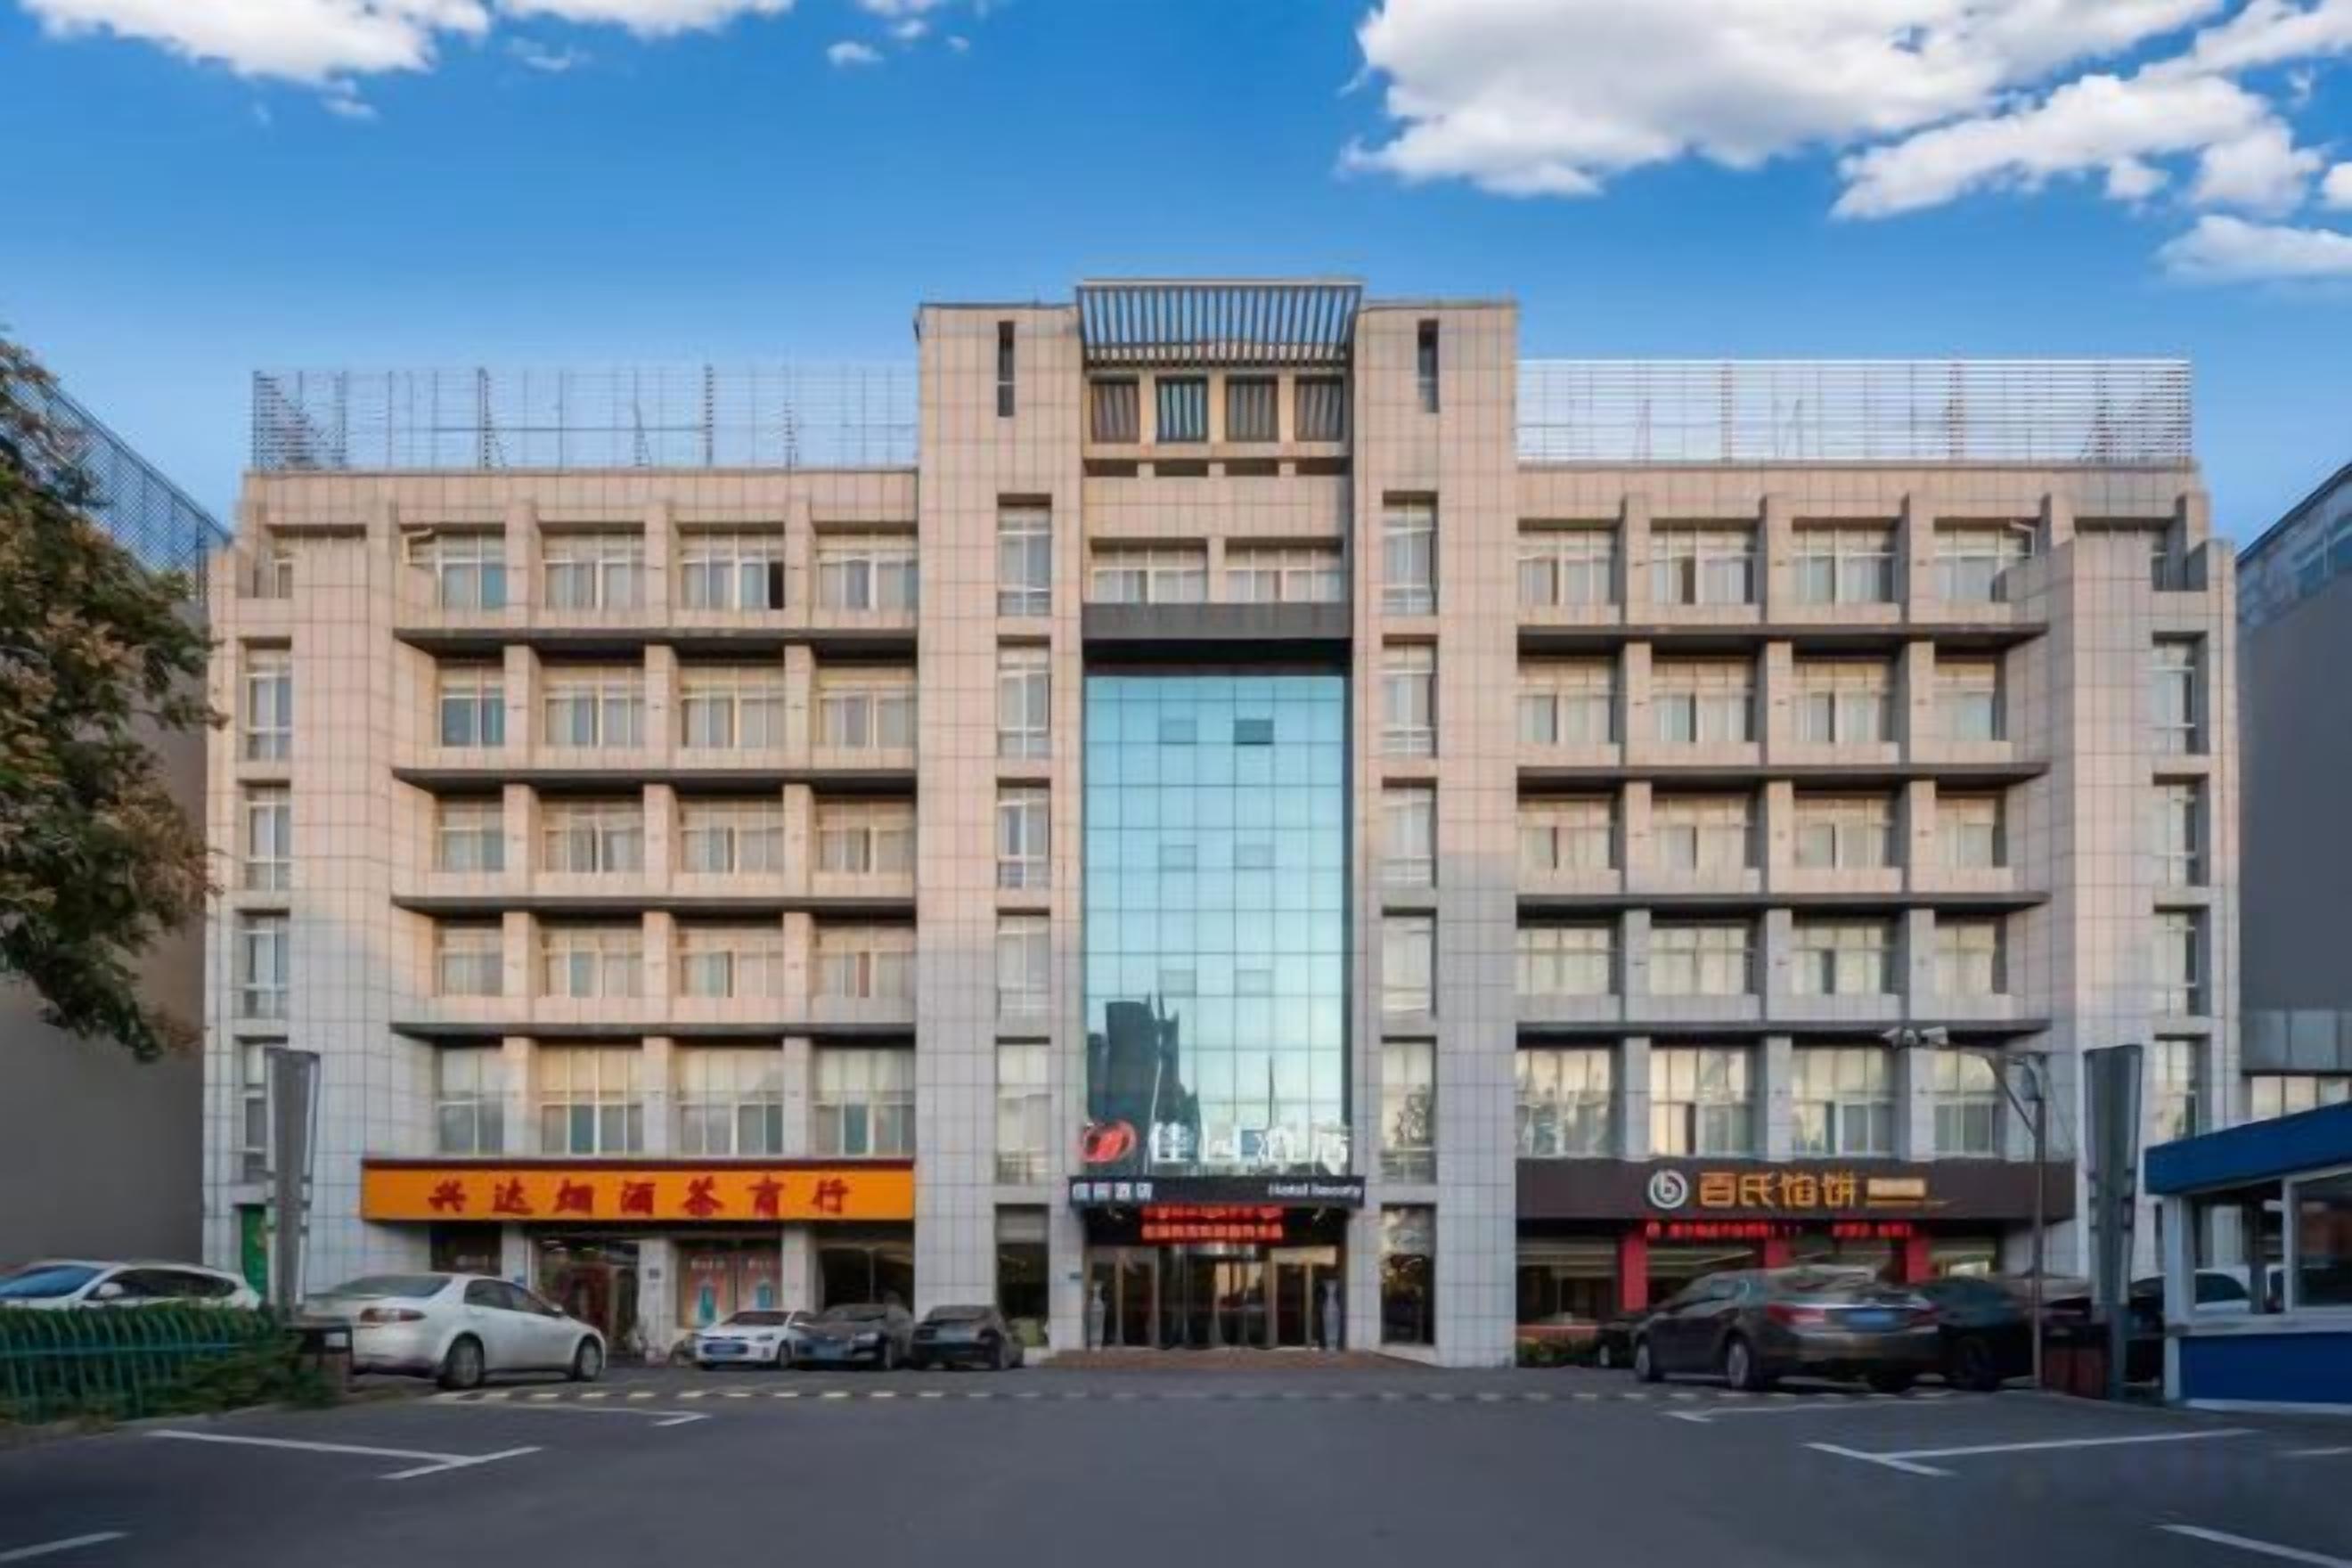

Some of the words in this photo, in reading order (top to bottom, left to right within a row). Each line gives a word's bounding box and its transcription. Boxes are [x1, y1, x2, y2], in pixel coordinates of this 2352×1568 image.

[429, 1177, 849, 1216] 兴达烟酒茶商行
